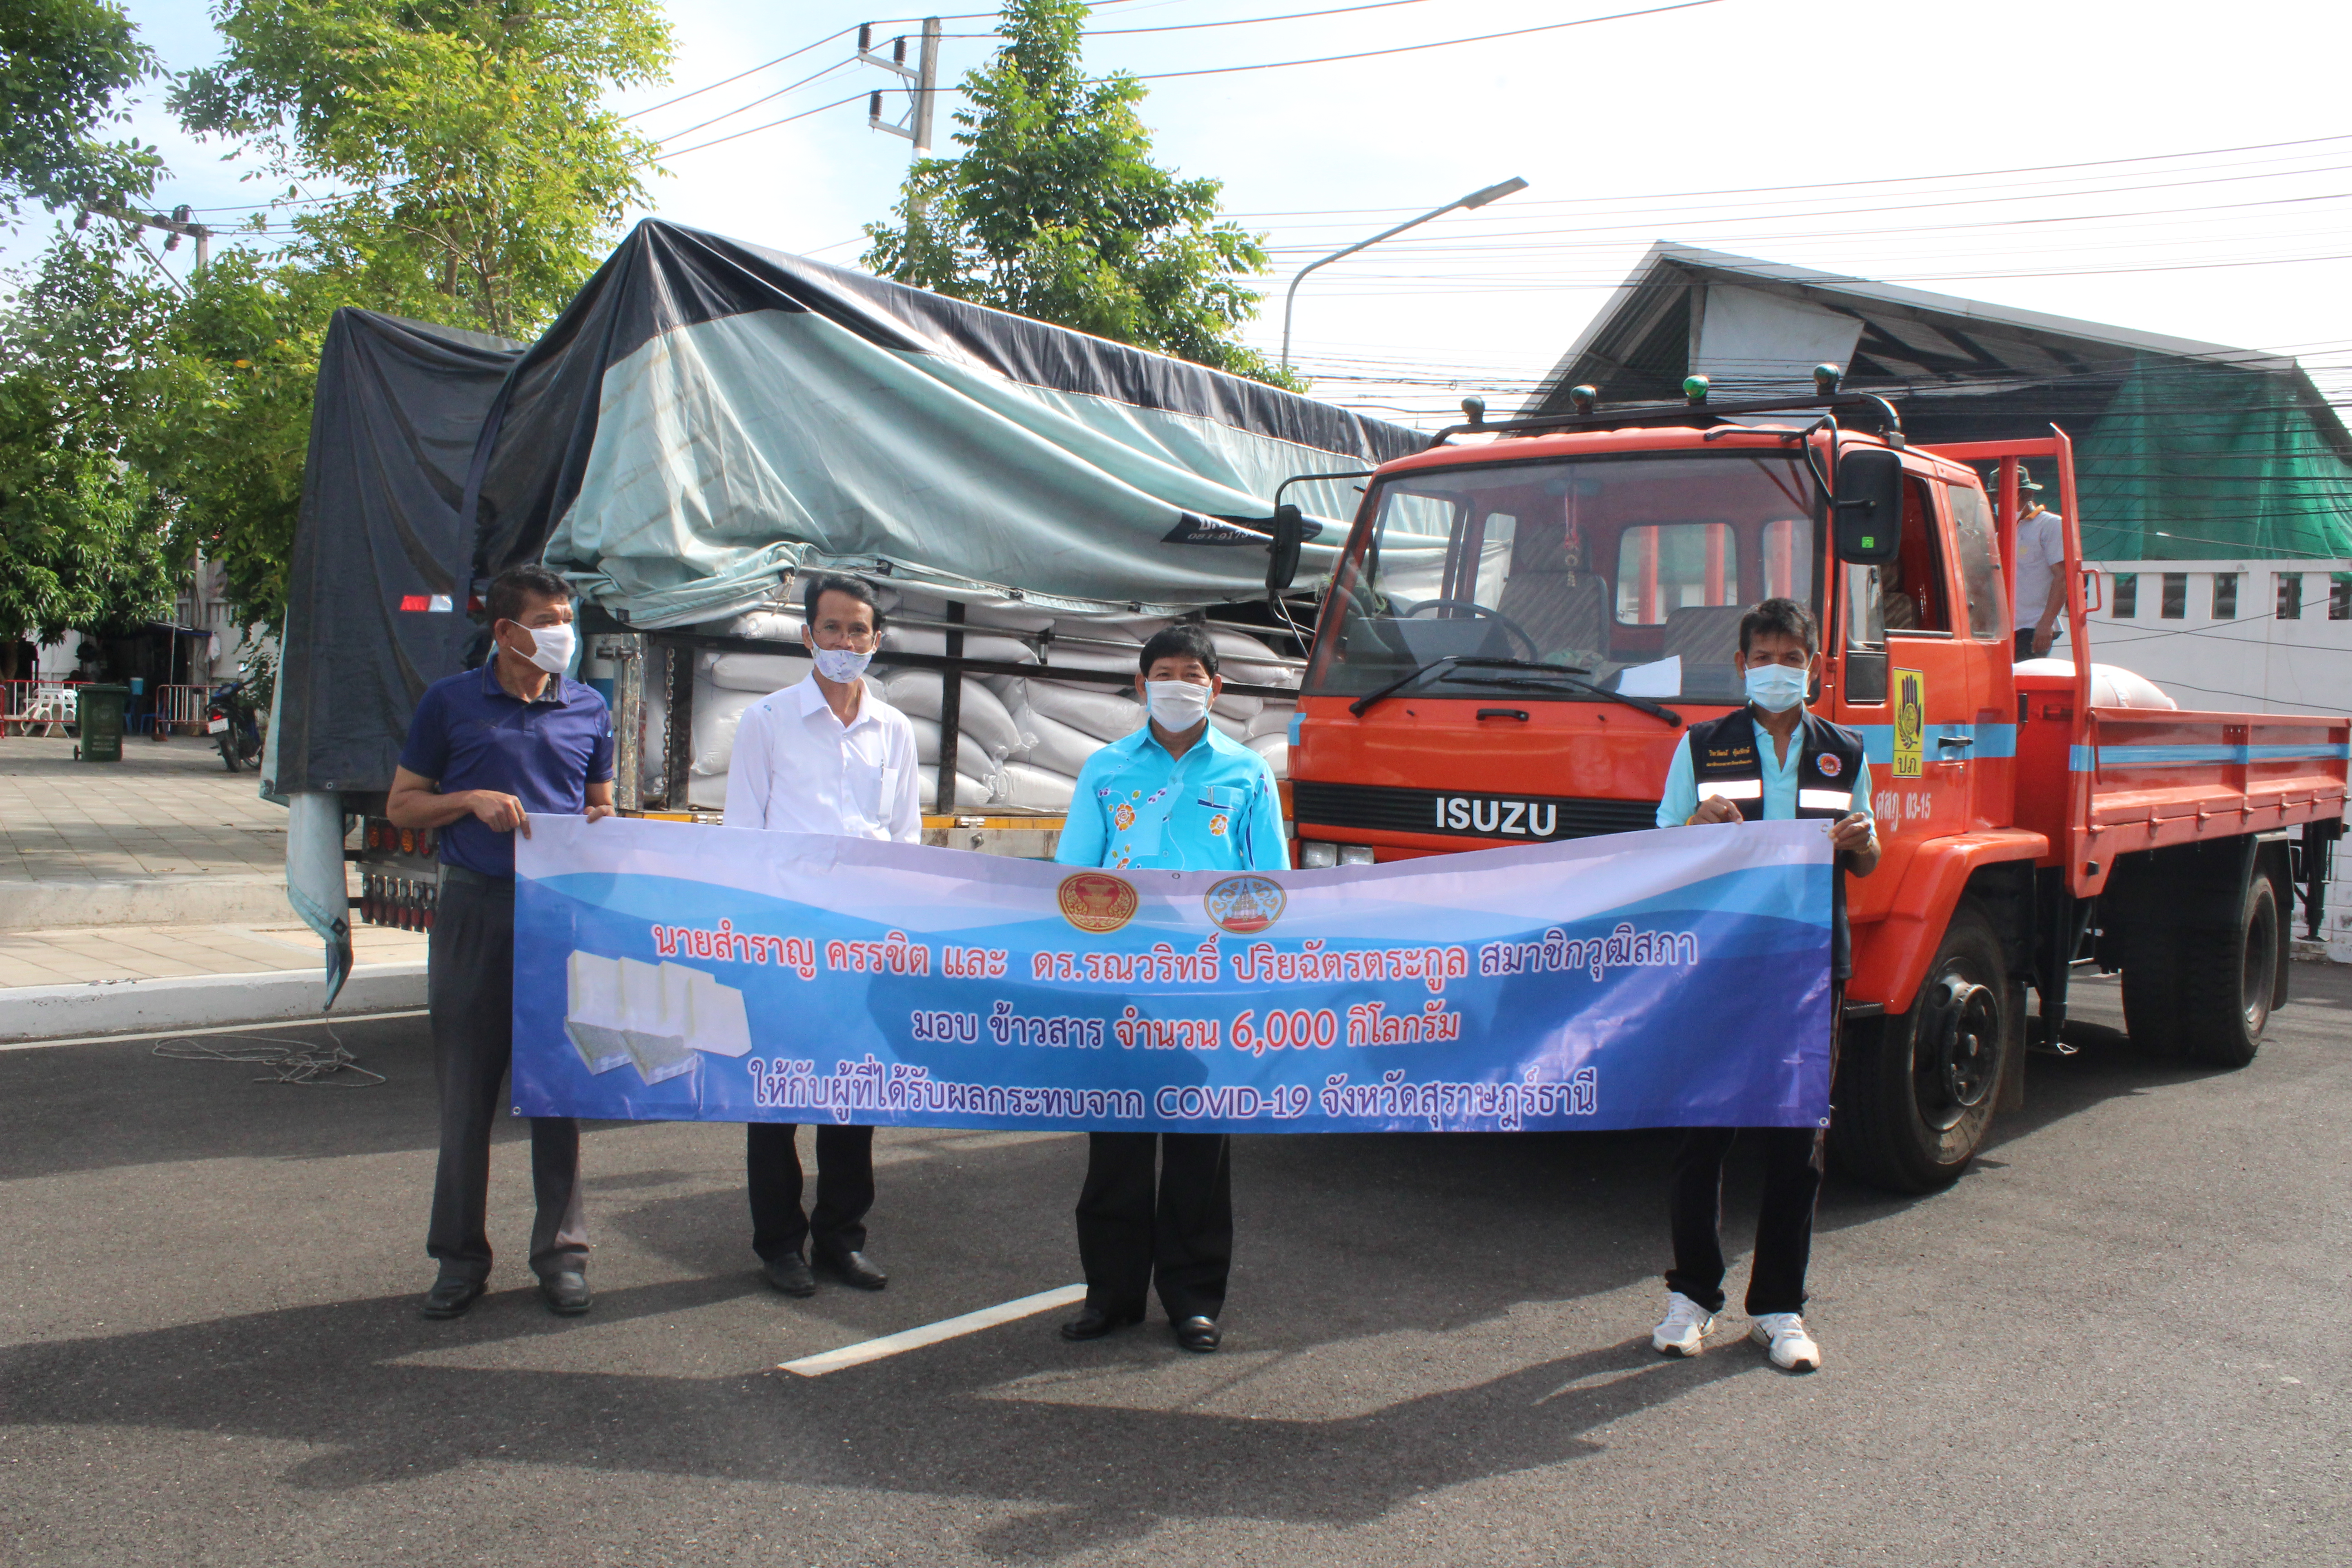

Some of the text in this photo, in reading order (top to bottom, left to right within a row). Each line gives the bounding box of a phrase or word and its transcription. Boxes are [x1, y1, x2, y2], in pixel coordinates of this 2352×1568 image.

[1897, 754, 1918, 773] ปภ.
[1436, 797, 1556, 836] ISUZU
[1906, 792, 1931, 819] 03-15
[652, 917, 1698, 993] นายสำราญ ครรชิต และ ดร.รณวริทธิ์ ปริยฉัตรตระกูล สมาชิกวุฒิสภา
[912, 999, 1461, 1058] มอบ ข้าวสาร จำนวน 6,000 กิโลกรัม
[748, 1054, 1597, 1130] ให้กับผู้ที่ได้รับผลกระทบจาก COVID-19 จังหวัดสุราษฎร์ธานี
